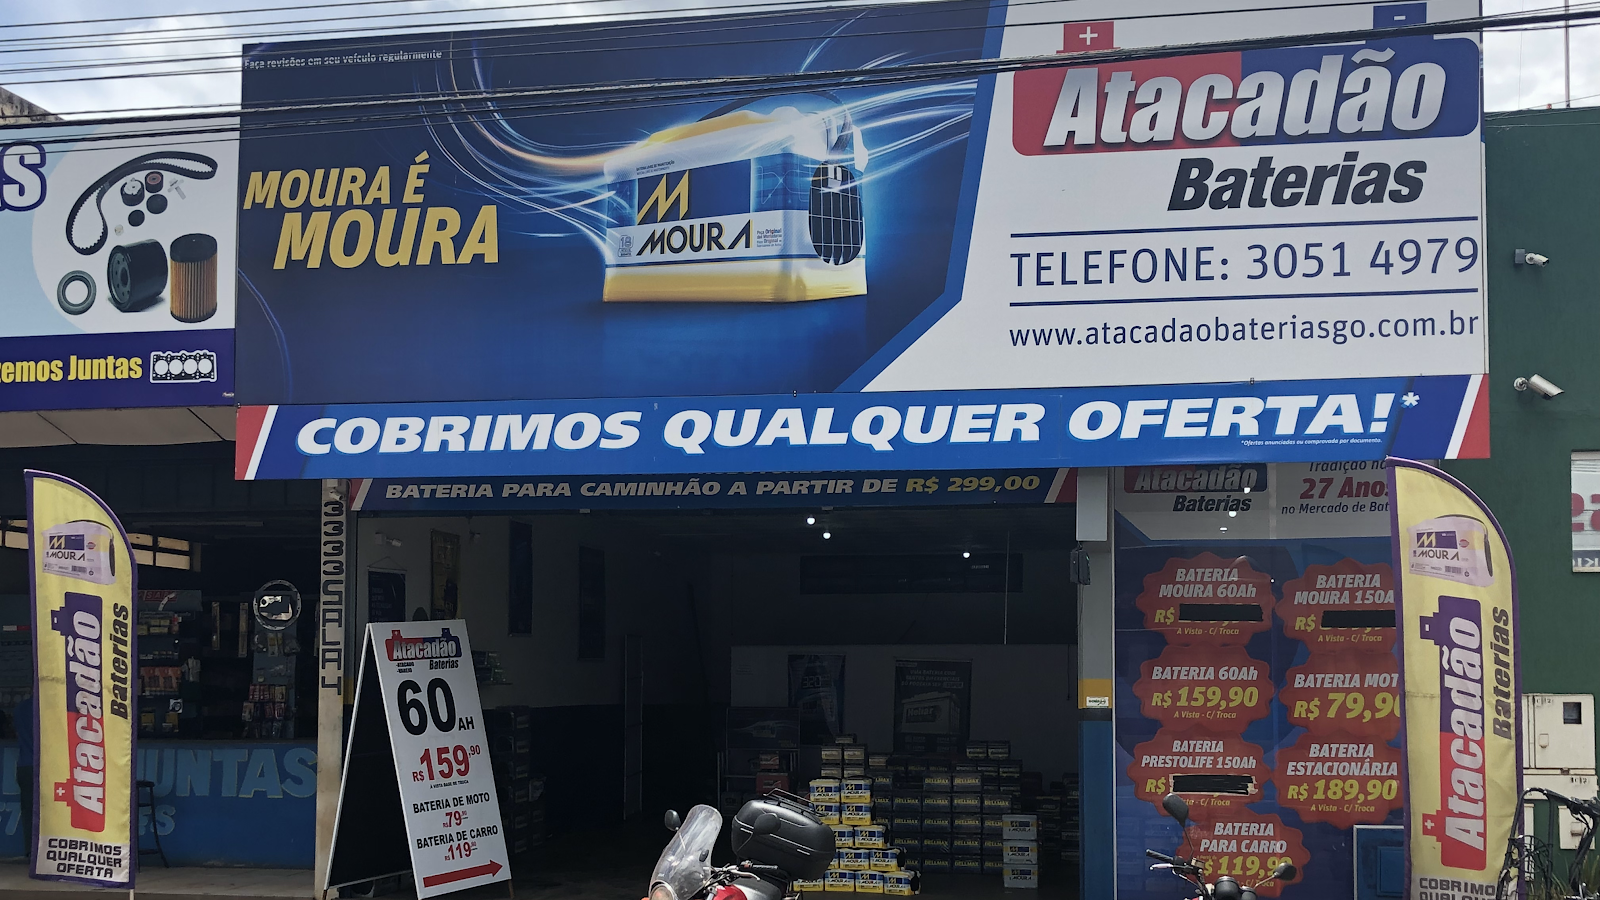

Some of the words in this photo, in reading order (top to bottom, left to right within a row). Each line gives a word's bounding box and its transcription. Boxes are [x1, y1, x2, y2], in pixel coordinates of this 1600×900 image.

[267, 57, 306, 68] revisões
[342, 53, 377, 64] veículo
[378, 50, 442, 63] regularmente
[1043, 48, 1447, 148] Atacadão
[243, 166, 391, 210] MOURA
[403, 150, 430, 204] É
[1167, 151, 1427, 211] Baterias
[273, 205, 499, 270] MOURA
[636, 219, 753, 256] MOURA
[1010, 245, 1229, 288] TELEFONE:
[1247, 242, 1352, 280] 3051
[1370, 236, 1479, 276] 4979
[1009, 311, 1479, 347] www.atacadaobateriasgo.com.br
[0, 359, 64, 384] emos
[68, 355, 143, 381] Juntas
[297, 411, 642, 456] COBRIMOS
[662, 403, 1043, 454] QUALQUER
[386, 484, 493, 499] BATERIA
[502, 480, 569, 498] PARA
[580, 477, 721, 497] CAMINHÃO
[727, 480, 748, 495] A
[756, 479, 854, 495] PARTIR
[862, 478, 898, 494] DE
[905, 476, 939, 495] R$
[947, 475, 1040, 494] 299,00
[1134, 464, 1258, 492] Atacadão
[1299, 477, 1334, 500] 27
[1337, 476, 1388, 499] Ano
[1172, 494, 1252, 512] Baterias
[1281, 506, 1295, 514] no
[1298, 502, 1348, 514] Mercado
[1352, 502, 1366, 513] de
[50, 550, 86, 562] MOURA
[1418, 549, 1460, 562] MOURA
[1176, 568, 1239, 582] BATERIA
[1316, 574, 1381, 588] BATERIA
[1158, 584, 1214, 598] MOURA
[1216, 584, 1257, 598] 60Ah
[1294, 590, 1350, 605] MOURA
[1154, 607, 1176, 626] R$
[1294, 614, 1317, 633] R$
[1318, 634, 1324, 642] A
[1326, 634, 1344, 642] Vista
[1362, 634, 1382, 642] Troca
[392, 637, 457, 660] Atacadão
[110, 602, 129, 720] Baterias
[429, 658, 459, 670] Baterias
[1152, 666, 1215, 680] BATERIA
[1218, 666, 1258, 680] 60Ah
[1294, 674, 1360, 688] BATERIA
[1492, 606, 1513, 741] Baterias
[397, 677, 456, 736] 60
[458, 716, 475, 732] AH
[1152, 690, 1173, 709] R$
[1176, 686, 1259, 711] 159,90
[67, 610, 105, 815] Atacadão
[1182, 710, 1200, 718] Vista
[1216, 710, 1237, 718] Troca
[1294, 697, 1321, 721] R$
[1442, 616, 1485, 852] Atacadão
[1172, 740, 1224, 753] BATERIA
[1309, 744, 1374, 758] BATERIA
[1141, 756, 1215, 768] PRESTOLIFE
[1216, 756, 1257, 770] 150Ah
[1286, 758, 1398, 776] ESTACIONÁRIA
[1146, 776, 1167, 795] R$
[1288, 782, 1309, 802] R$
[1313, 778, 1398, 804] 189,90
[412, 799, 451, 814] BATERIA
[454, 796, 464, 808] DE
[466, 792, 490, 805] MOTO
[1210, 798, 1230, 806] Troca
[1310, 804, 1316, 812] A
[1318, 804, 1338, 812] Vista
[1355, 804, 1376, 812] Troca
[417, 834, 454, 849] BATERIA
[456, 831, 468, 842] DE
[470, 824, 498, 840] CARRO
[1214, 822, 1274, 837] BATERIA
[48, 838, 122, 857] COBRIMOS
[1200, 839, 1238, 852] PARA
[1241, 840, 1288, 854] CARRO
[46, 850, 122, 869] QUALQUER
[56, 862, 114, 878] OFERTA
[1419, 877, 1507, 898] COBRIMO
